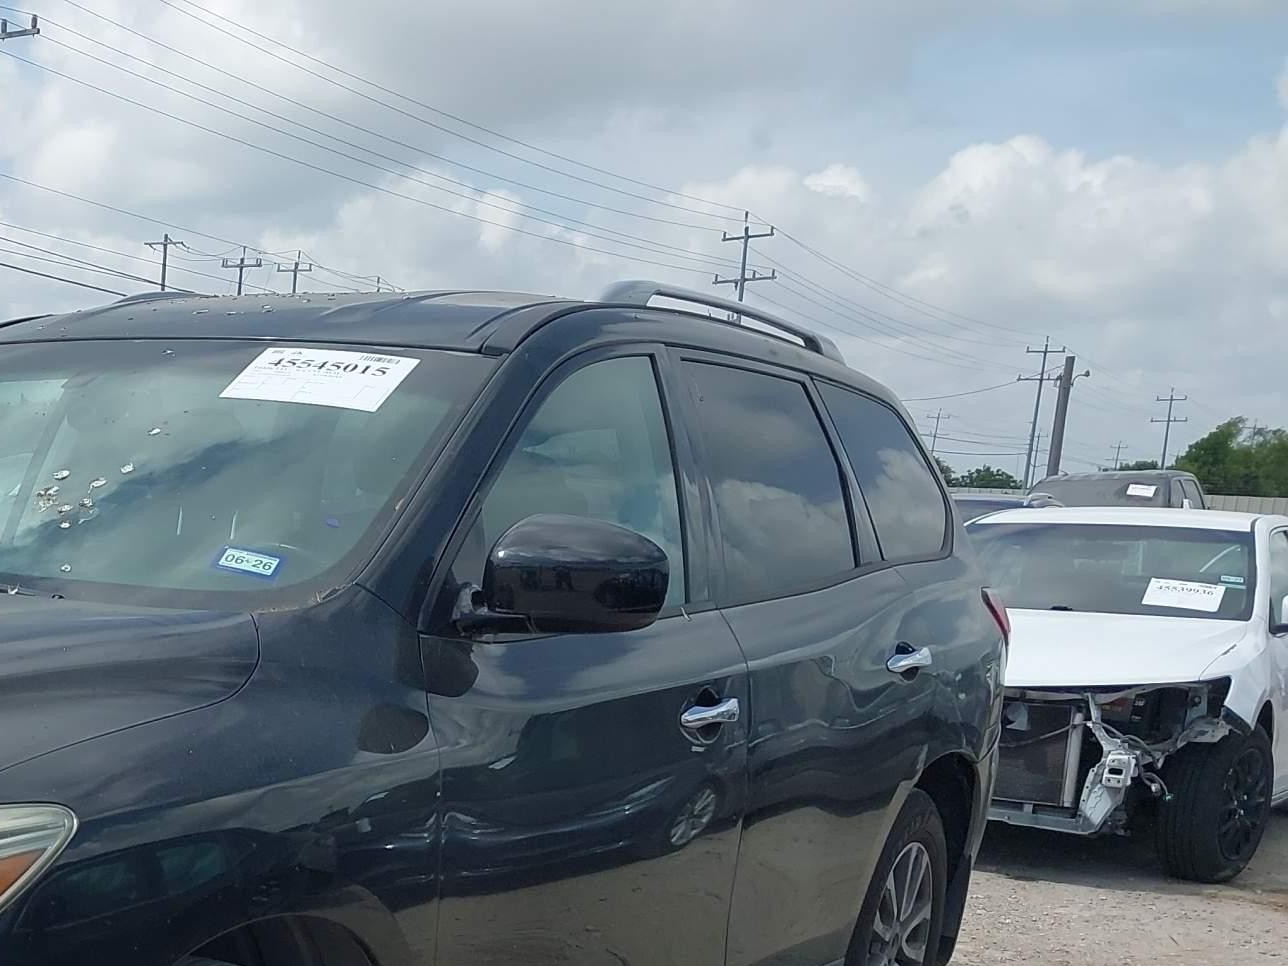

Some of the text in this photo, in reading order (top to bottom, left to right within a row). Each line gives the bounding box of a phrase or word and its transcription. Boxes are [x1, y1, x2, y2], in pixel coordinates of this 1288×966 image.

[267, 356, 391, 377] 45545015
[224, 553, 274, 571] 06 26
